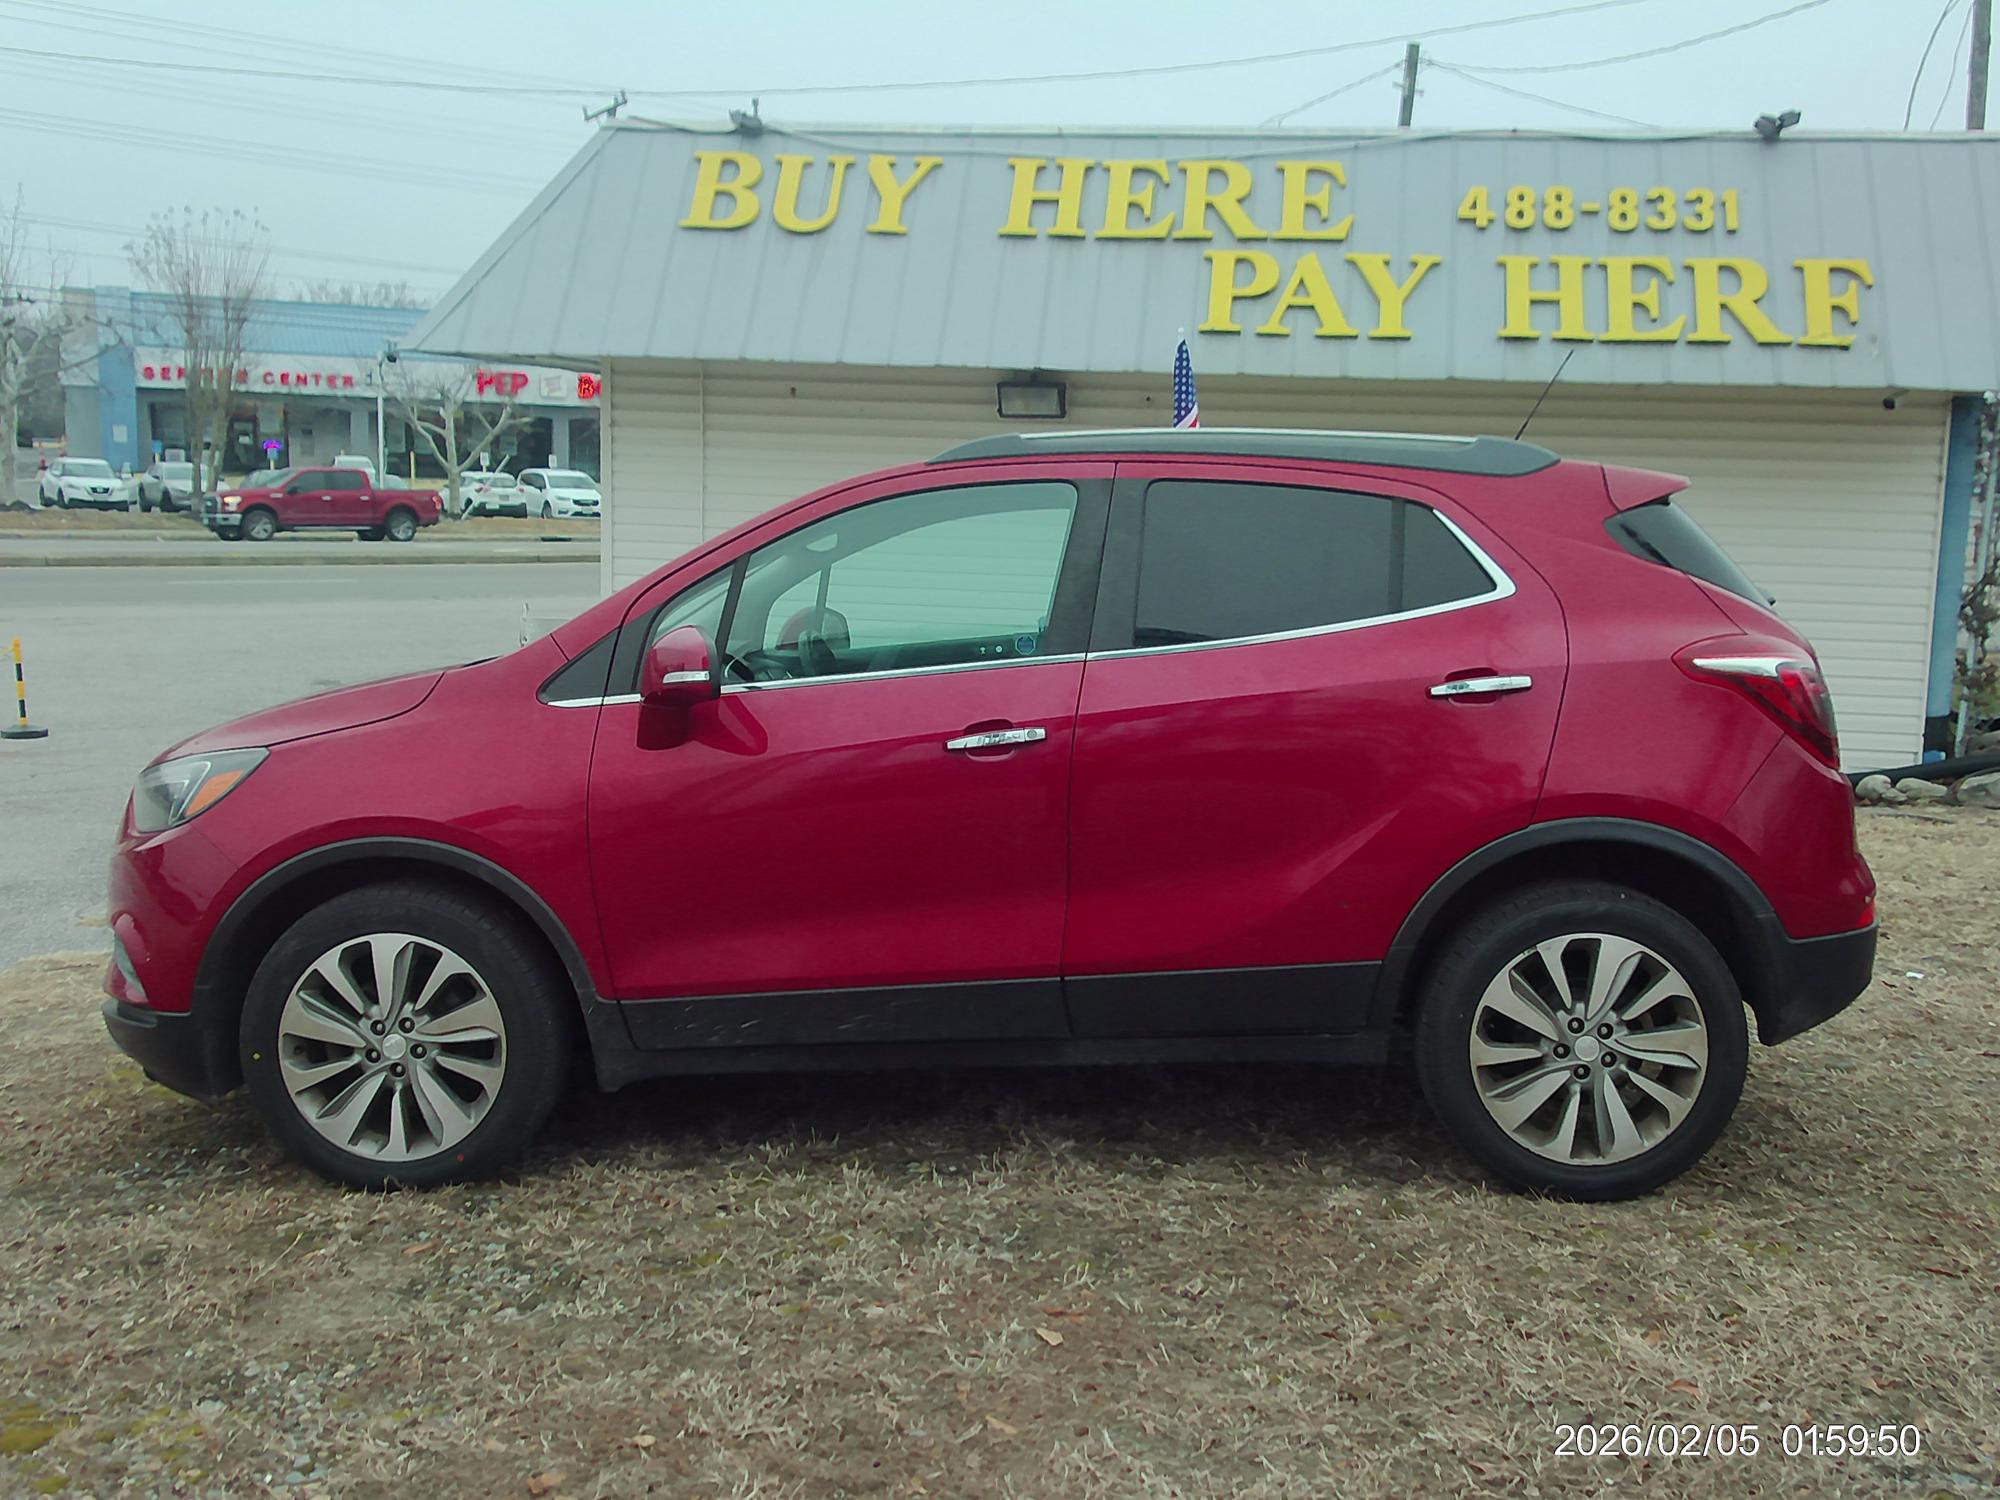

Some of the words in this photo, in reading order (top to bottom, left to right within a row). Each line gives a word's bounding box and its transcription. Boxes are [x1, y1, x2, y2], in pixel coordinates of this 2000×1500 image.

[680, 151, 942, 234] BUY
[998, 158, 1353, 240] HERE
[1458, 186, 1740, 231] 488-8331
[1199, 249, 1442, 337] PAY
[262, 370, 355, 389] CENTER
